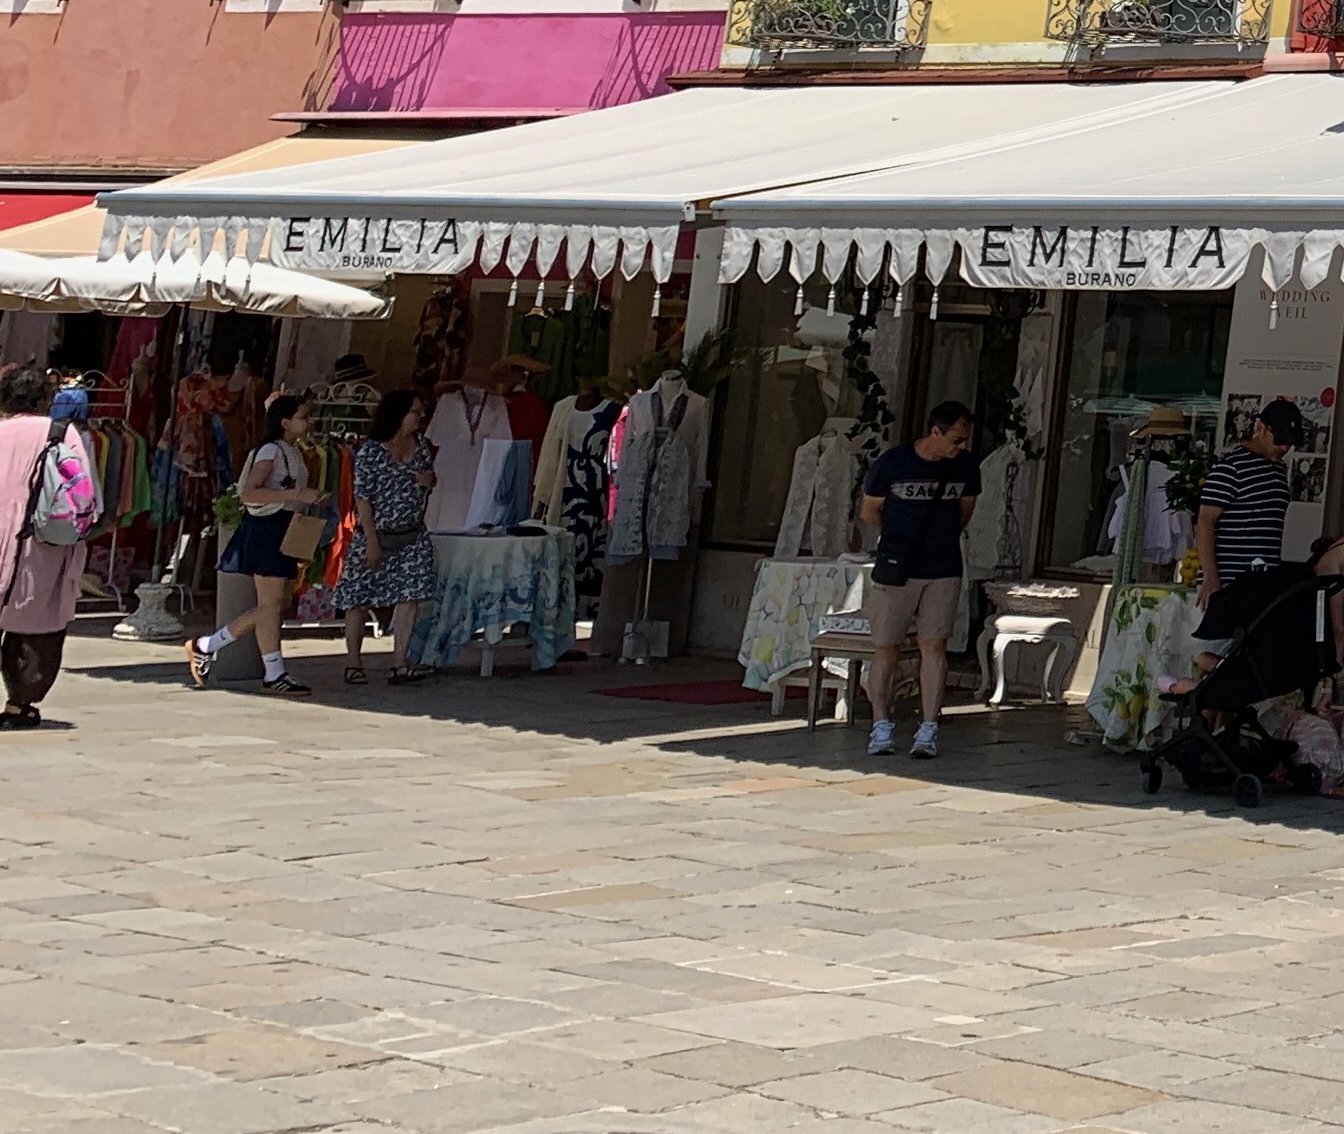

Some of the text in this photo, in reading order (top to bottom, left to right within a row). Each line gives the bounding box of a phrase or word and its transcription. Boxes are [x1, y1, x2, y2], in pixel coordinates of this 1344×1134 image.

[284, 216, 459, 254] EMILIA
[979, 223, 1226, 269] EMILIA
[342, 255, 393, 269] BURANO
[1066, 272, 1137, 287] BURANO
[1259, 289, 1330, 303] WEDDING
